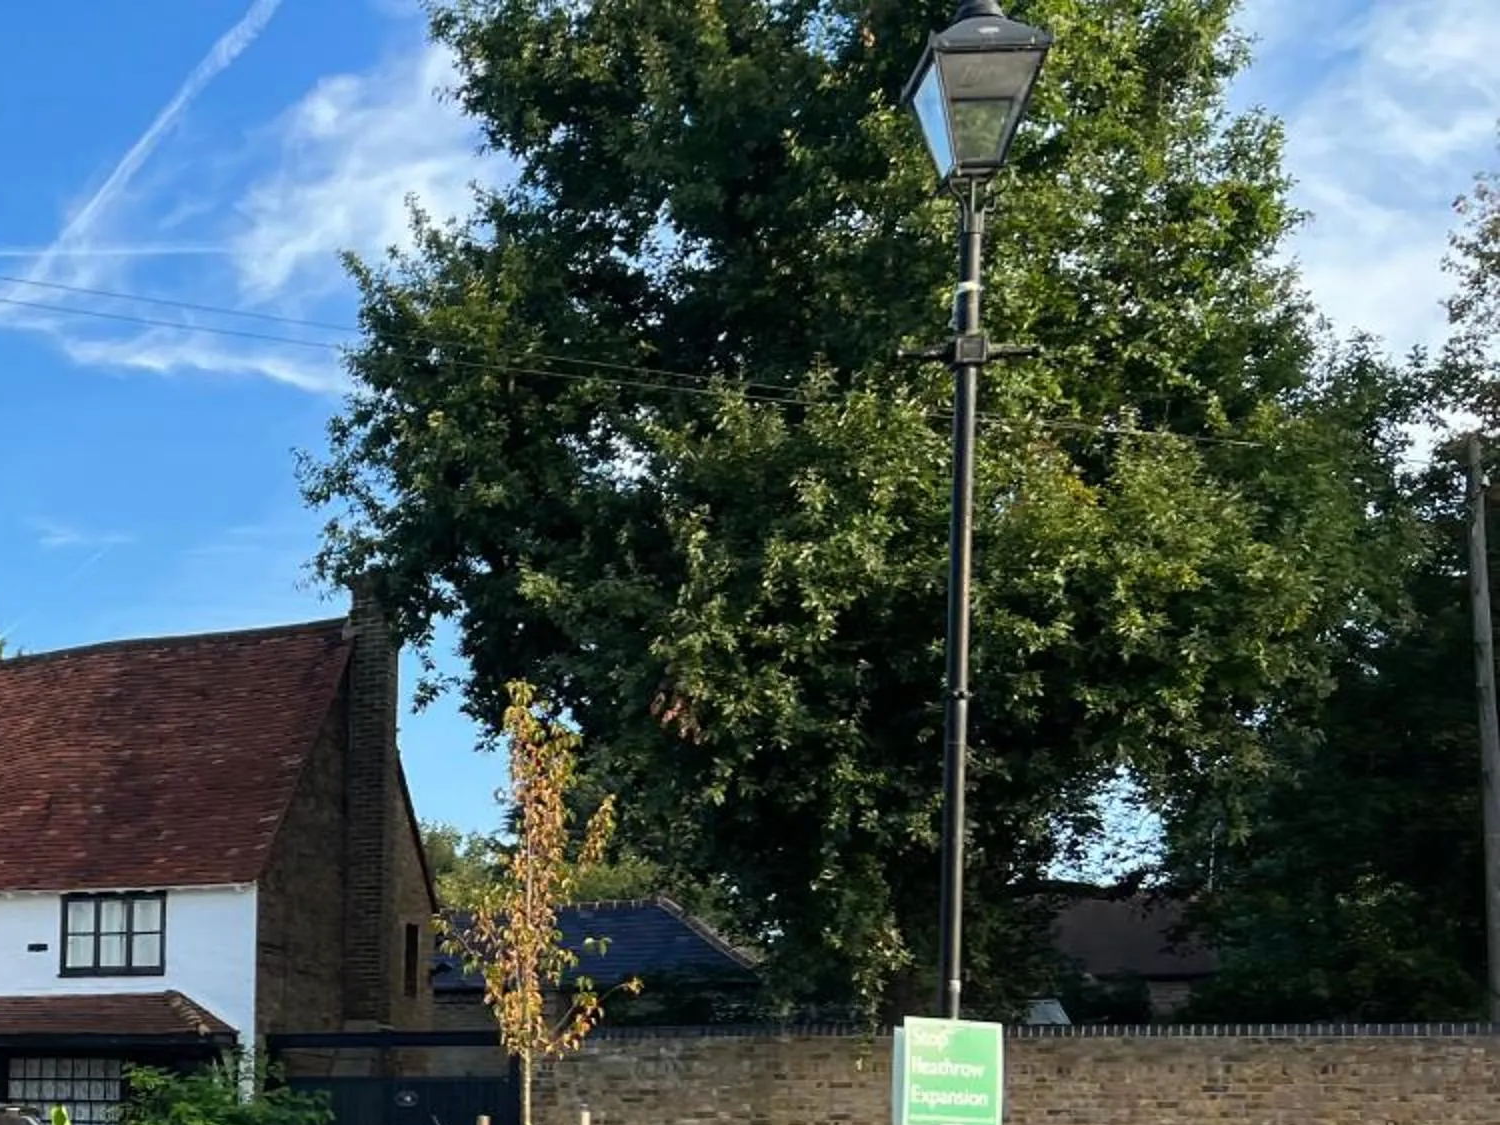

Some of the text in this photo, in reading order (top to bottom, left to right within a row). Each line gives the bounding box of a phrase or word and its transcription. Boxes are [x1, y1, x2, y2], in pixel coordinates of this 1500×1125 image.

[910, 1026, 949, 1053] Stop
[910, 1056, 985, 1079] Heathrow
[910, 1084, 989, 1111] Expansion
